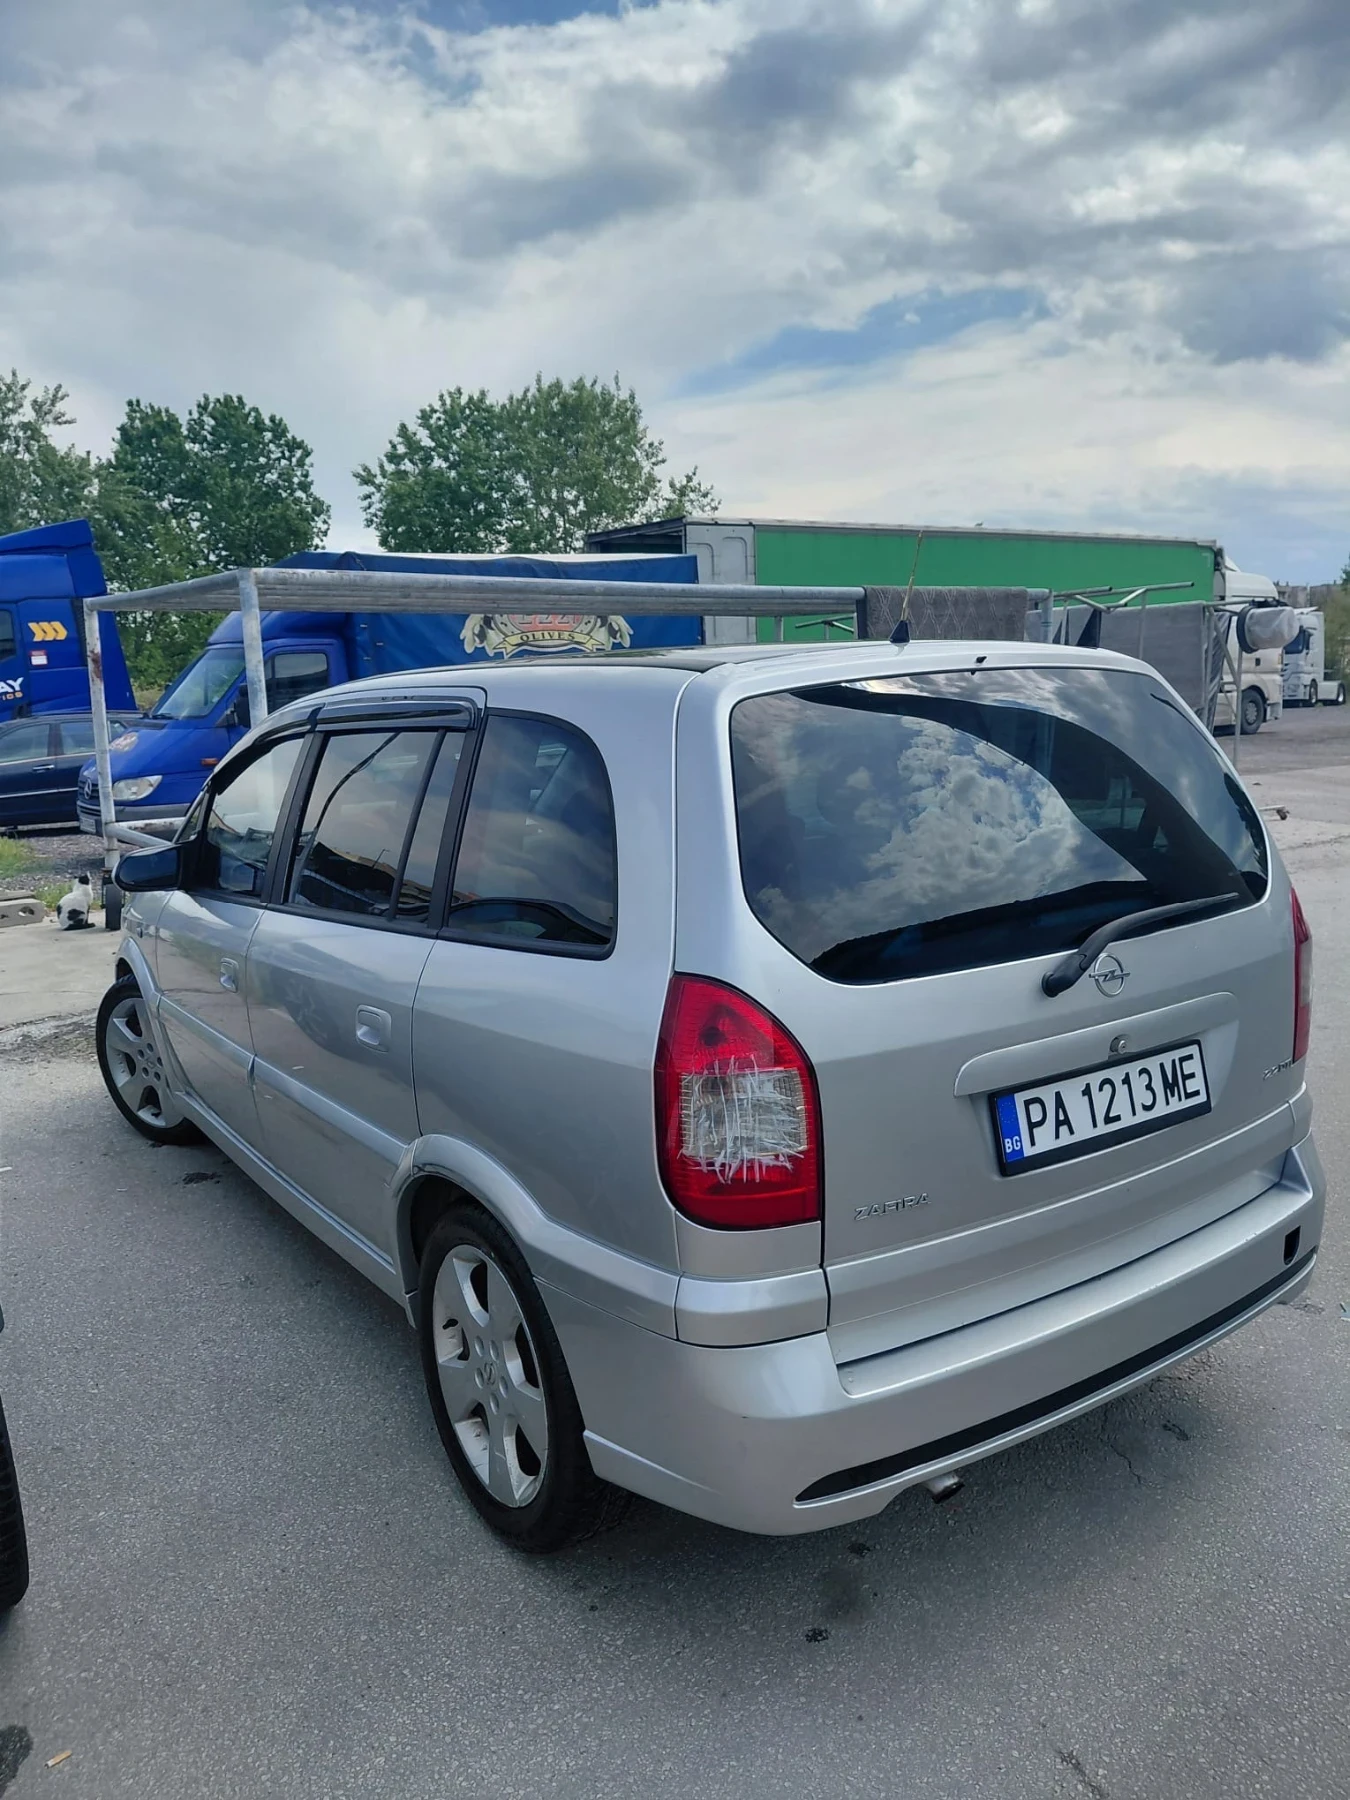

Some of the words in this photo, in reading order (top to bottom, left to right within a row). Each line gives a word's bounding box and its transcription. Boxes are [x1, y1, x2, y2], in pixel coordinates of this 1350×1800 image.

[520, 631, 576, 642] OLIVES
[1023, 1090, 1075, 1147] PA
[1081, 1067, 1157, 1129] 1213
[1159, 1053, 1201, 1106] ME
[1004, 1136, 1021, 1153] BG
[854, 1192, 932, 1221] ZAFIRA
